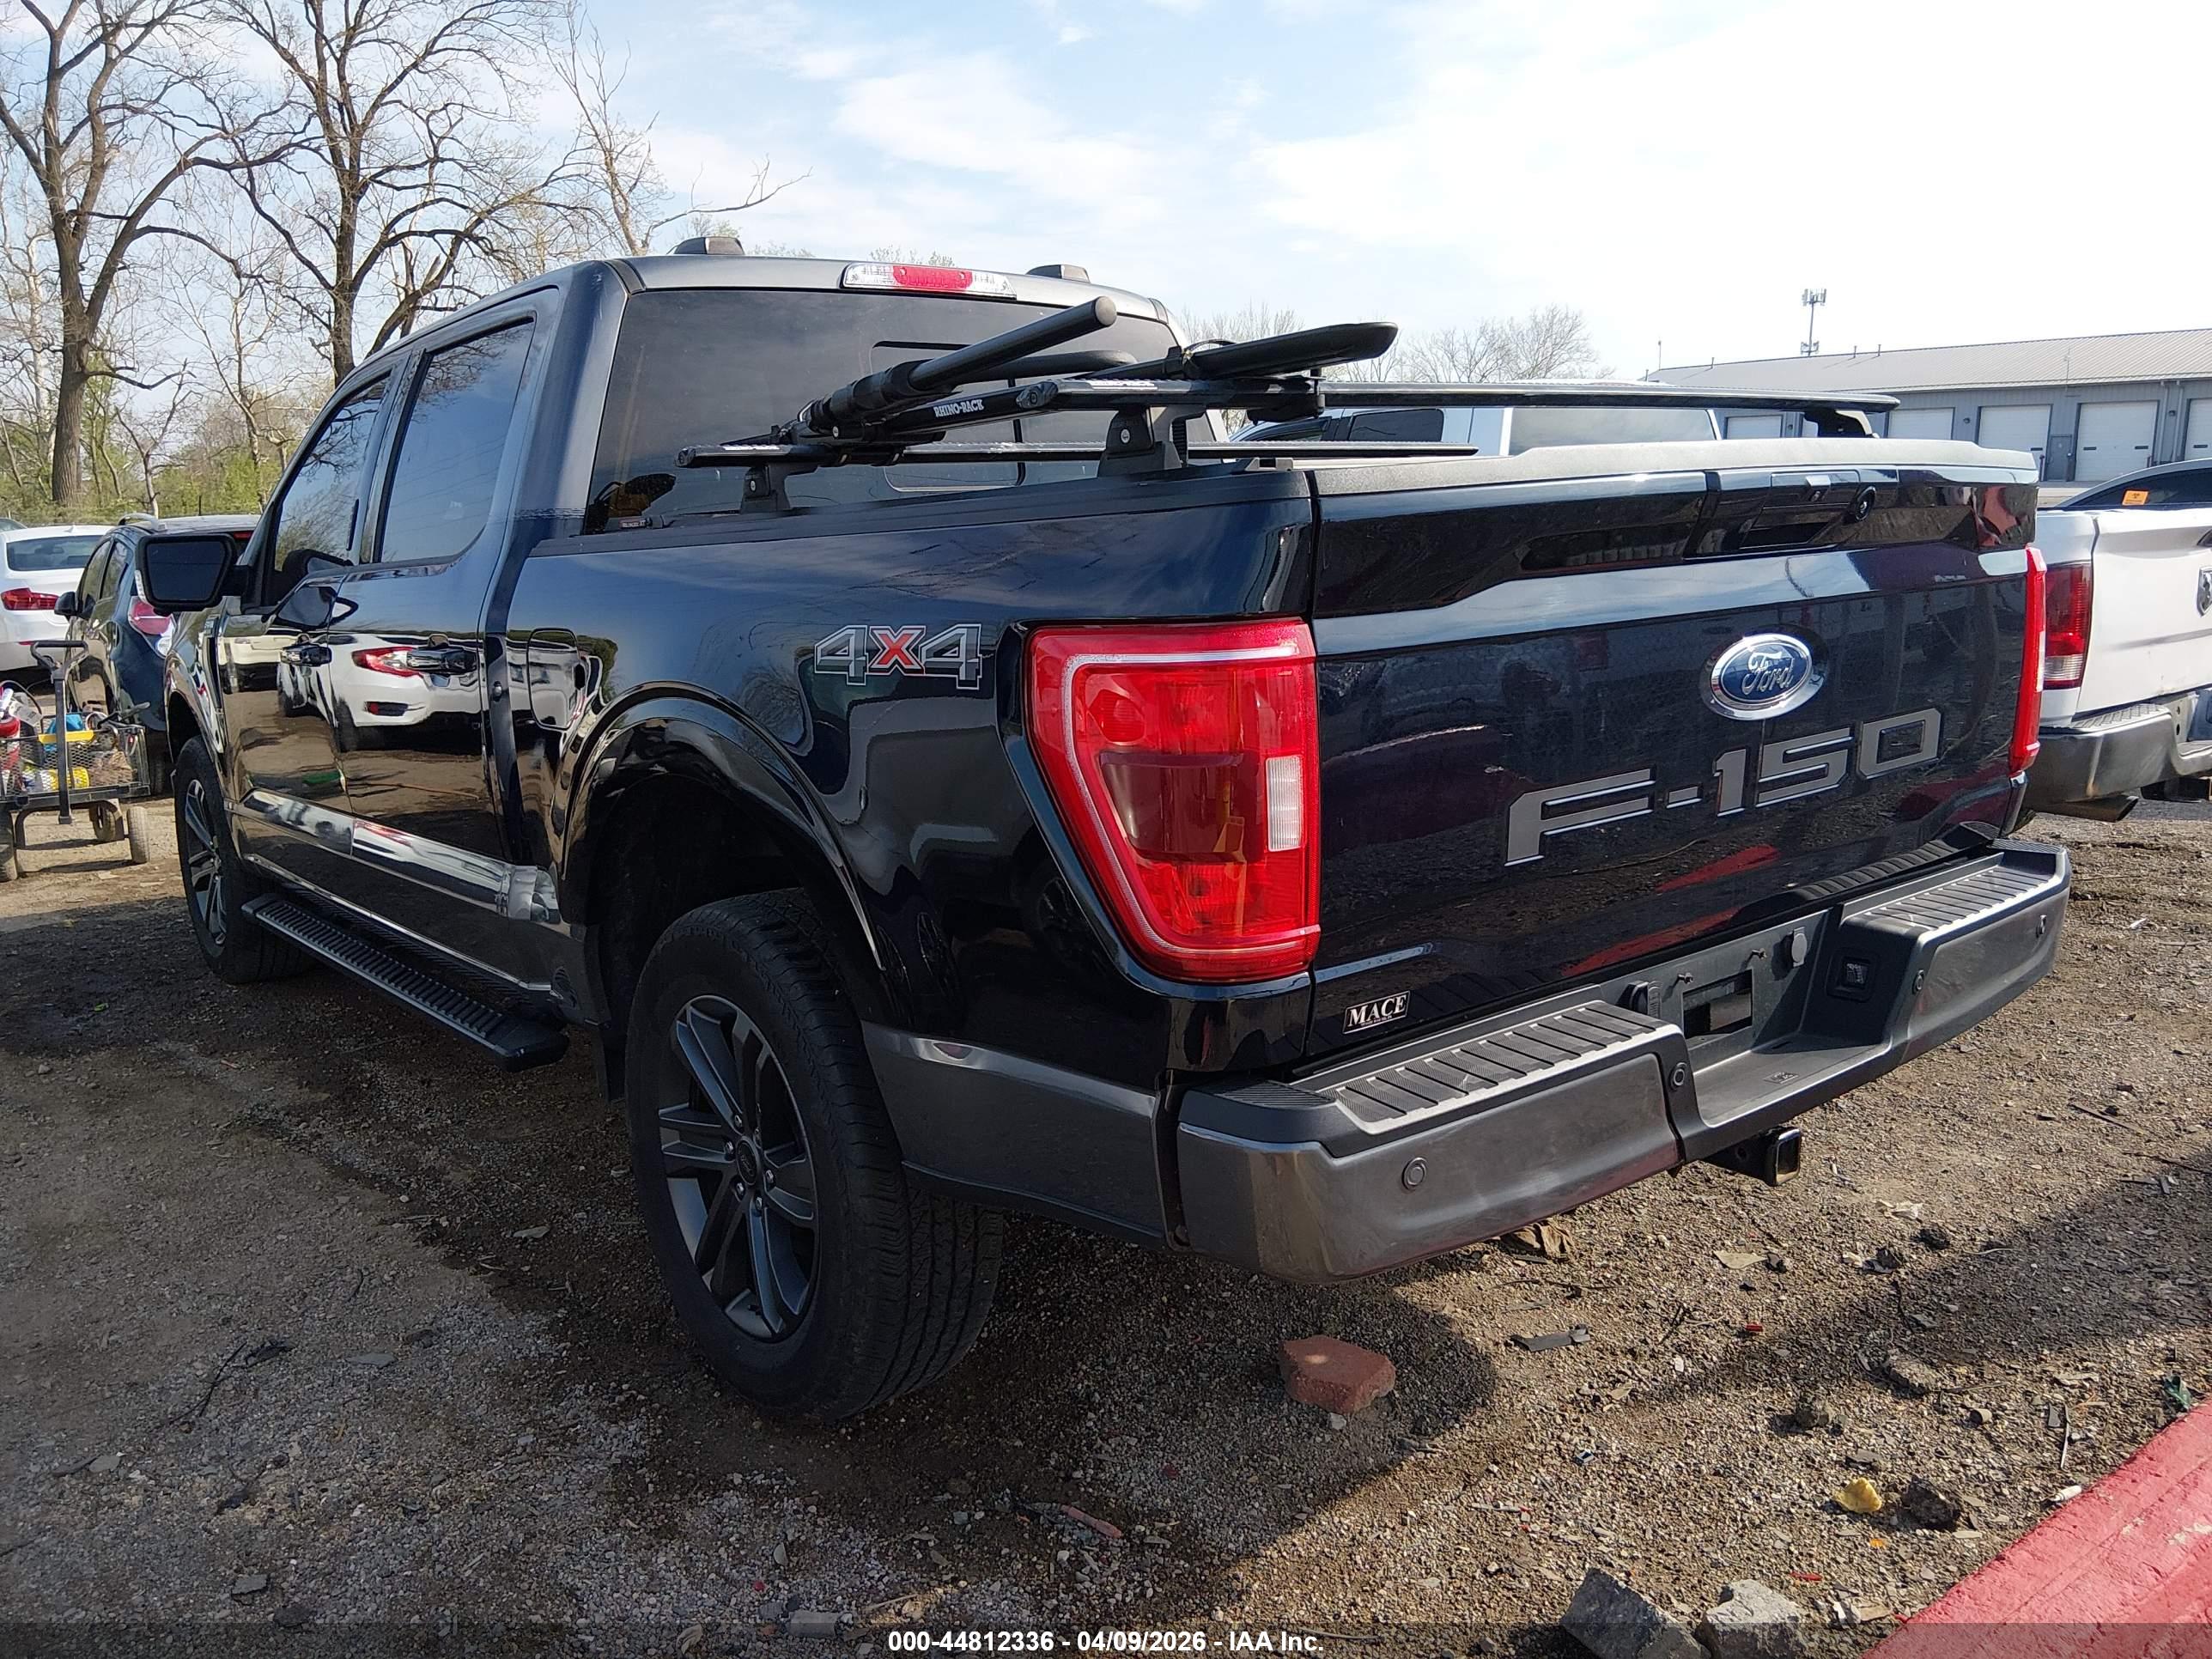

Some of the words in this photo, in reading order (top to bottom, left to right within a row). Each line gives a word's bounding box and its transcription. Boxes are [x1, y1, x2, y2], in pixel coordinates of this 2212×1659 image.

[933, 399, 984, 417] RHINO-RACK
[1741, 651, 1795, 696] Ford
[1504, 707, 1942, 866] F-150
[1347, 994, 1407, 1027] MACE
